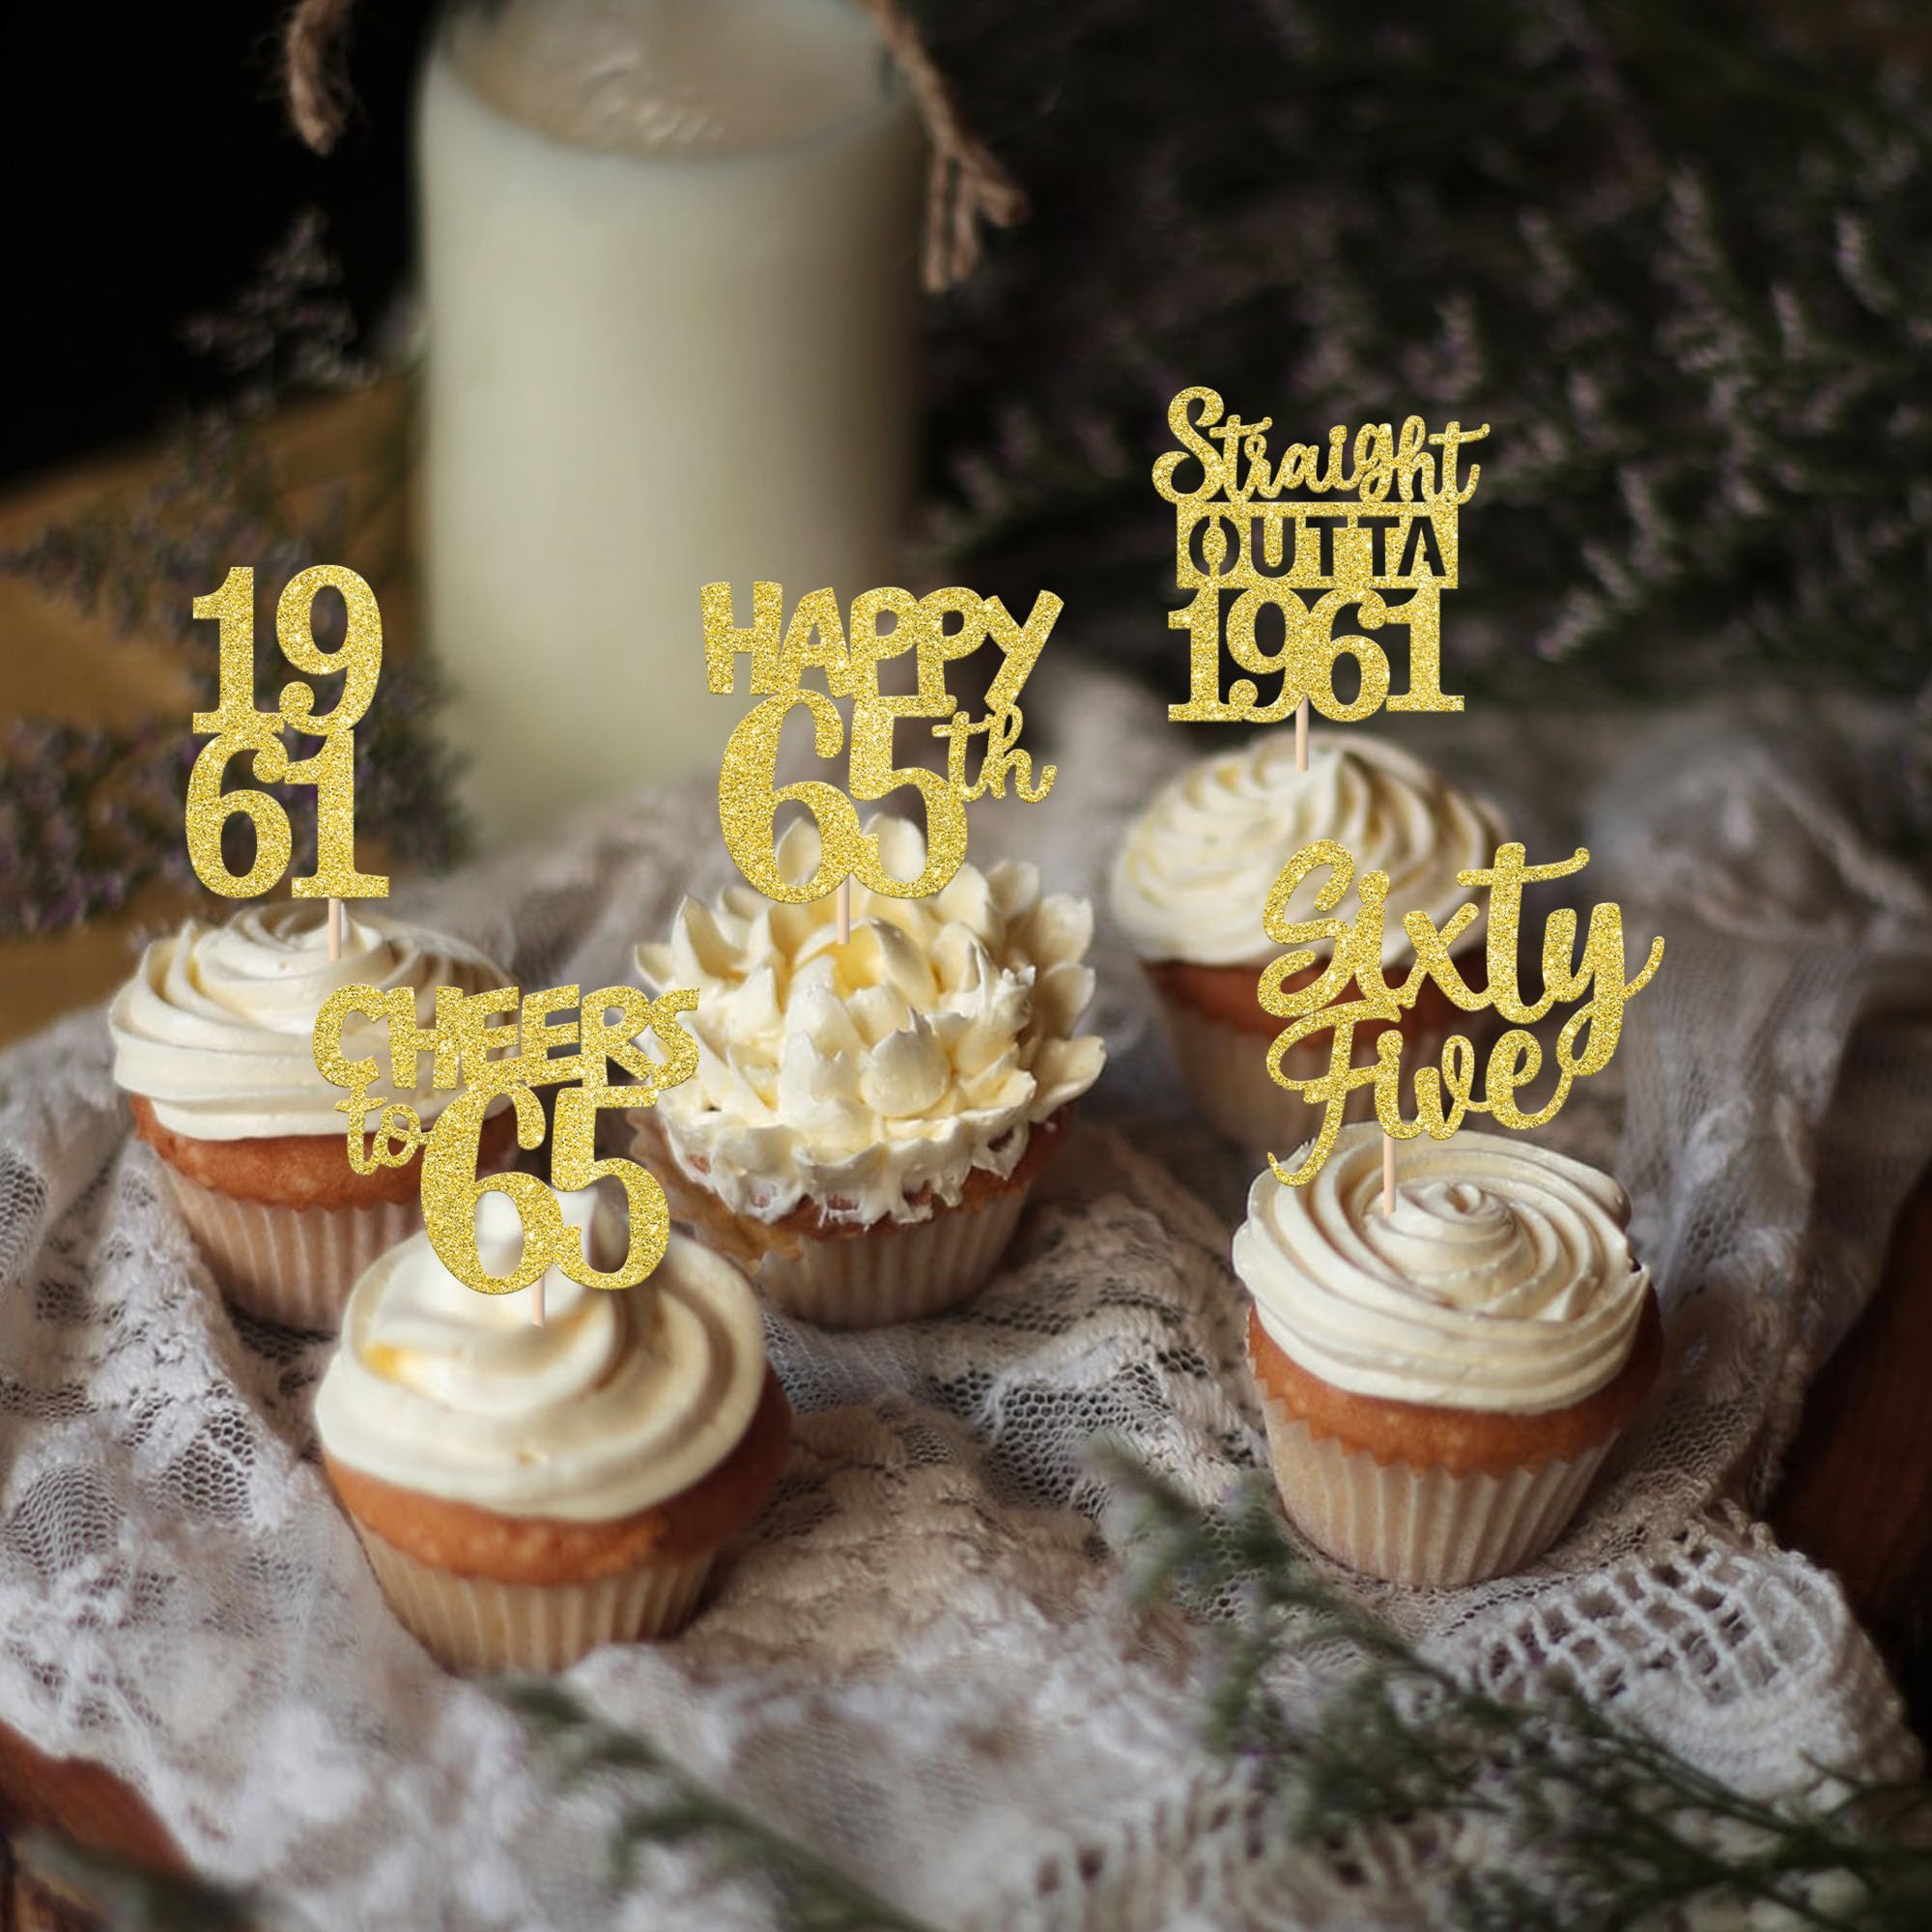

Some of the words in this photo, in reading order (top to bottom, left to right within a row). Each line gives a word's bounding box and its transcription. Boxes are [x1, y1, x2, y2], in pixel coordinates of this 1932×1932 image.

[1152, 386, 1491, 504] Straight
[1189, 516, 1447, 578] OUTTA
[700, 582, 1065, 713] HAPPY
[1168, 583, 1465, 723] 1961
[1258, 839, 1665, 1076] Sixty
[313, 983, 700, 1090] CHEERS
[1266, 999, 1575, 1187] Five
[335, 1082, 426, 1176] to
[421, 1083, 669, 1294] 65
